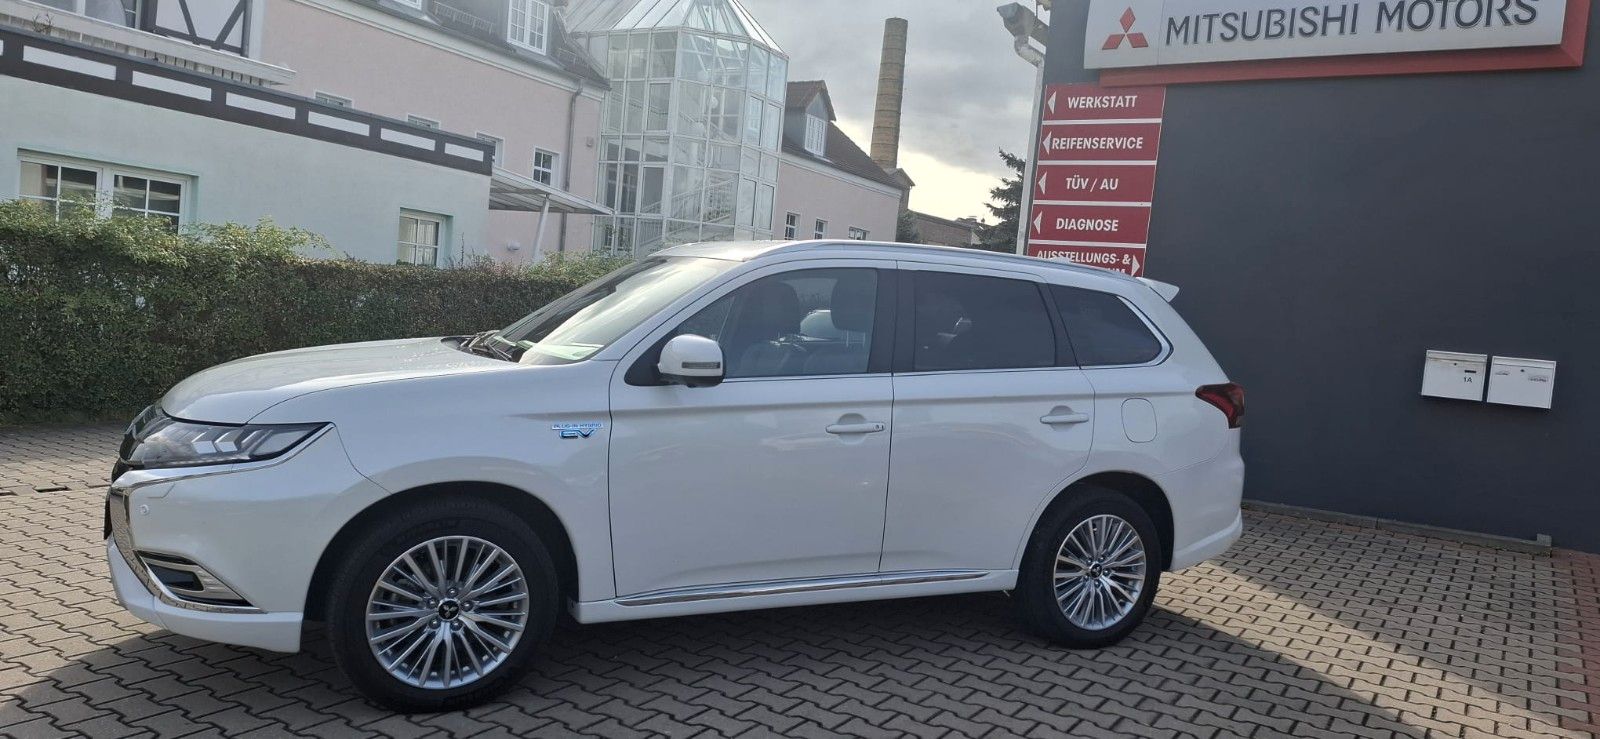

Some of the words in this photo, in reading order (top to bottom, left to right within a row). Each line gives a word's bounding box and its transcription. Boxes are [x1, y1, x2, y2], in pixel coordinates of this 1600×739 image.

[1165, 3, 1359, 45] MITSUBISHI
[1375, 0, 1538, 33] MOTORS
[1067, 95, 1138, 108] WERKSTATT
[1051, 136, 1144, 149] REIFENSERVICE
[1066, 175, 1089, 190] TÜV
[1090, 178, 1098, 192] /
[1100, 178, 1119, 190] AU
[1056, 218, 1119, 231] DIAGNOSE
[1122, 254, 1132, 265] &
